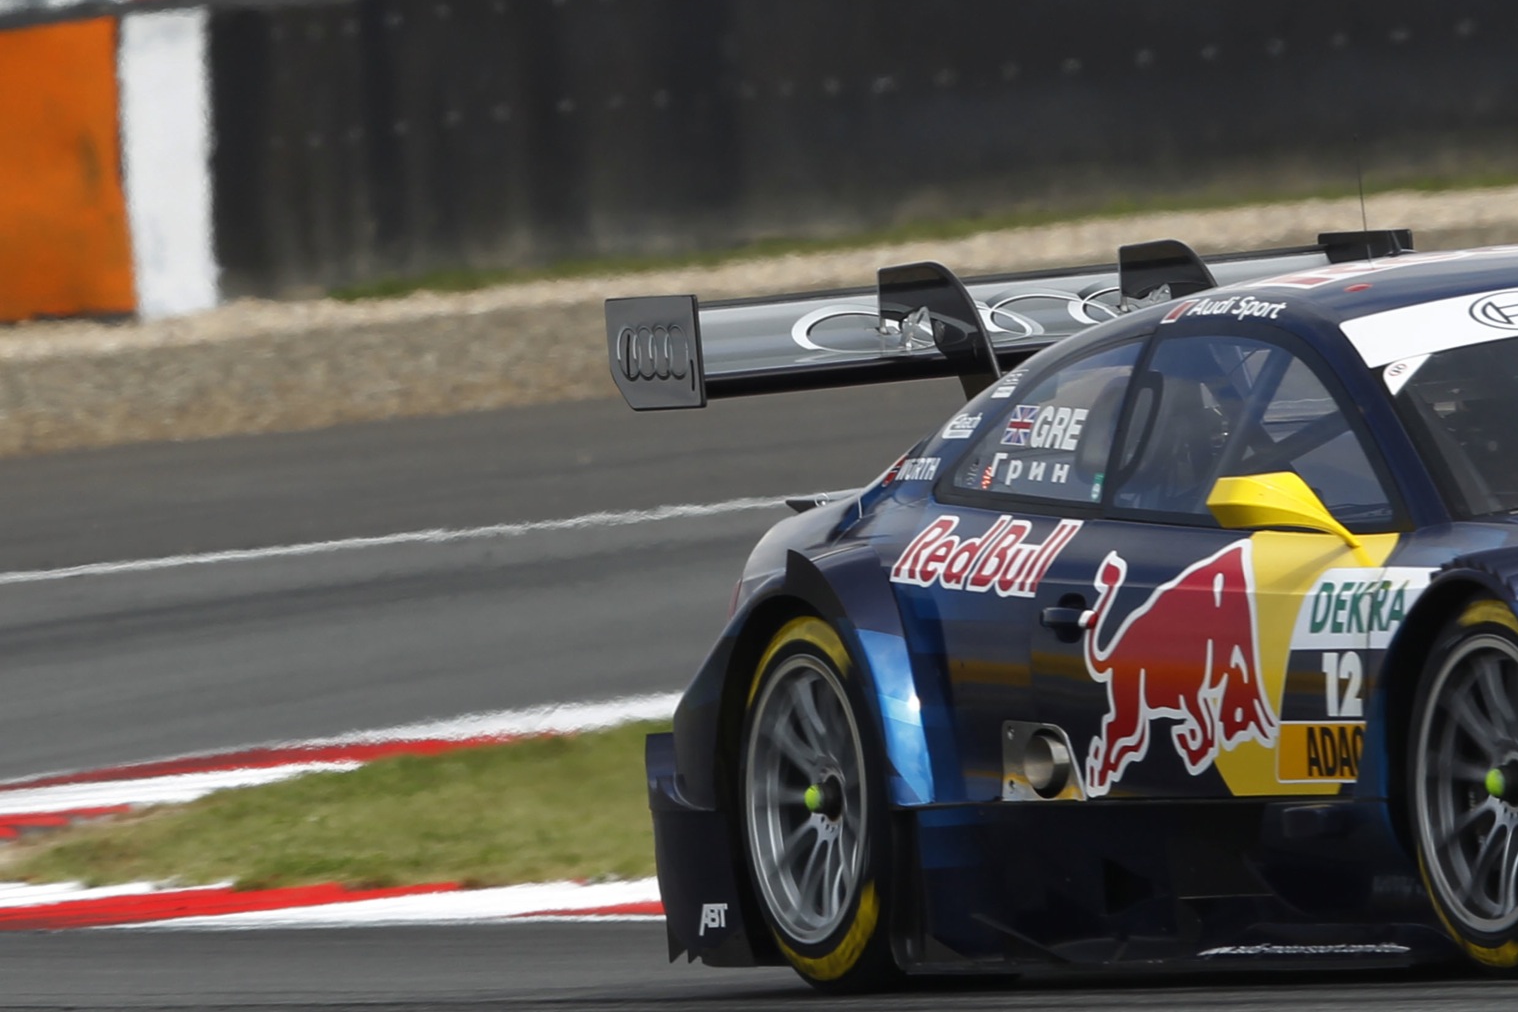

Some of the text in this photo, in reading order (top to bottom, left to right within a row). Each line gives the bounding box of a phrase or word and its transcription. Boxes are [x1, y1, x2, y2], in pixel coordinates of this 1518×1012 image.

[1186, 296, 1287, 321] Audi Sport
[1030, 405, 1089, 451] GRE
[989, 452, 1071, 486] Грин
[890, 516, 1083, 597] Red Bull
[1309, 579, 1409, 634] DEKRA
[1321, 651, 1364, 717] 12
[700, 902, 728, 935] ABT
